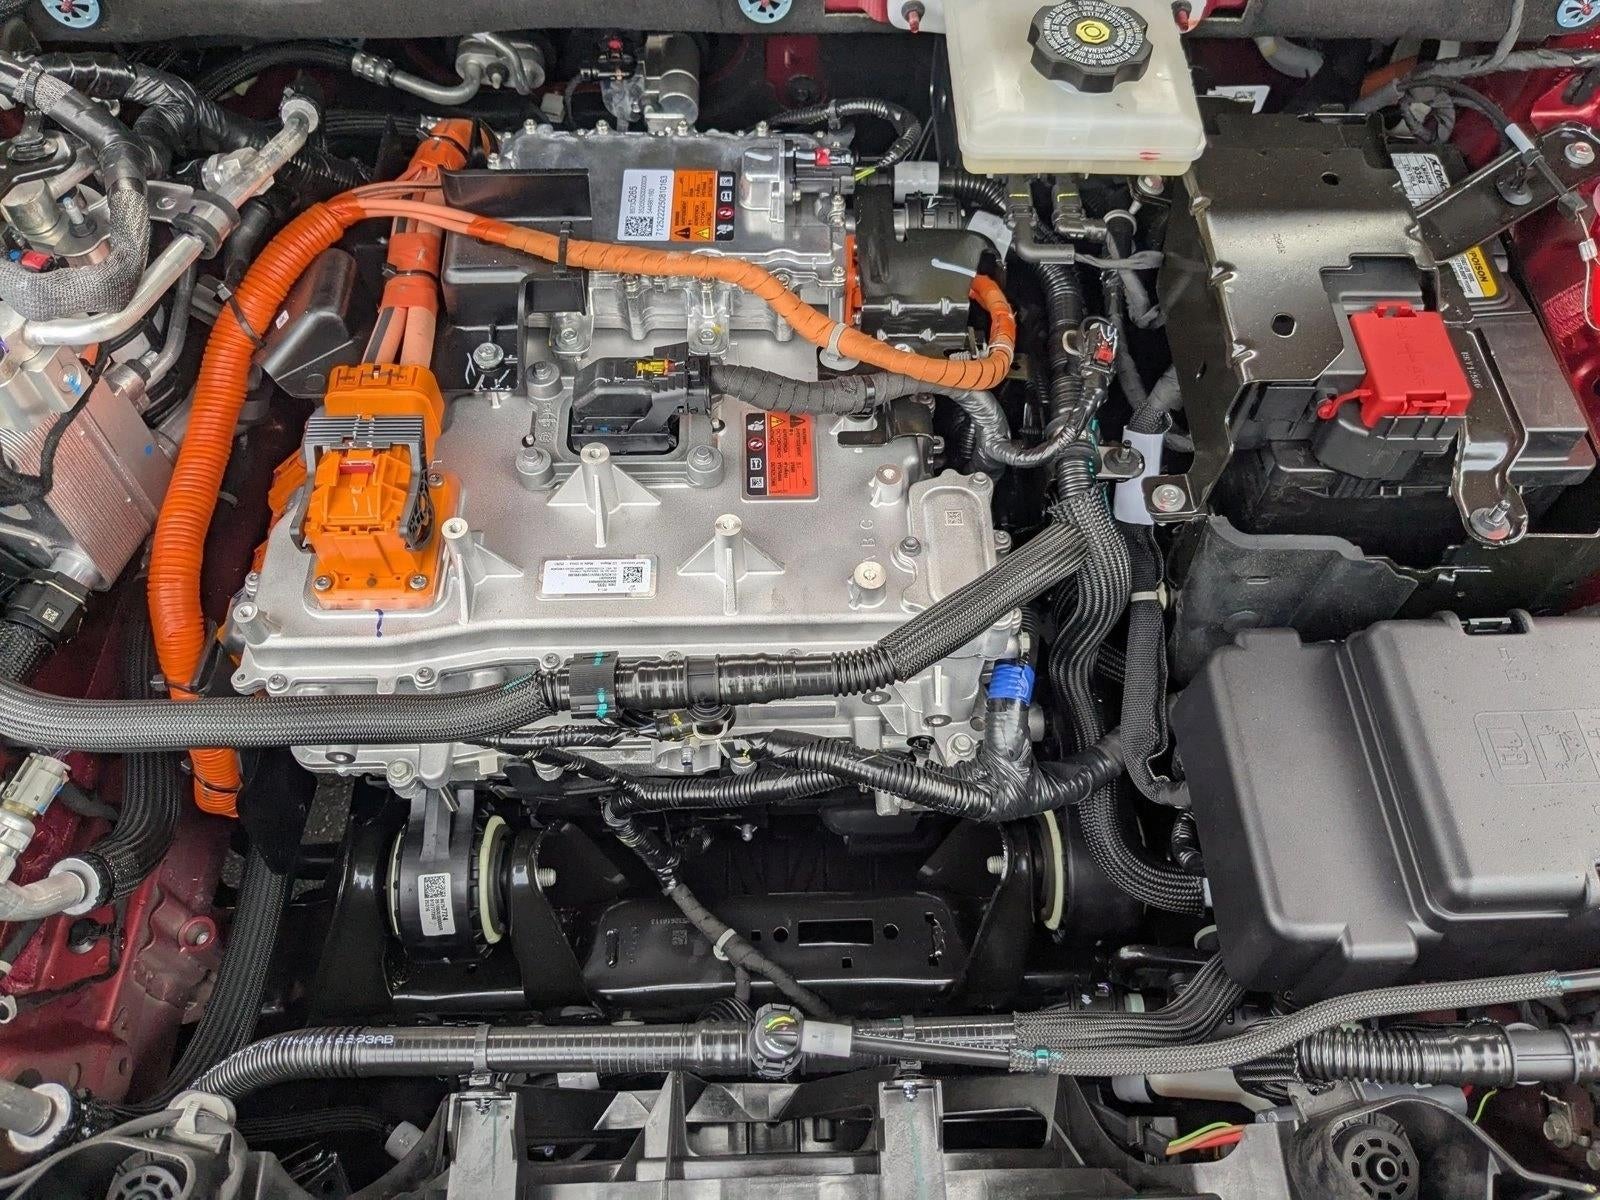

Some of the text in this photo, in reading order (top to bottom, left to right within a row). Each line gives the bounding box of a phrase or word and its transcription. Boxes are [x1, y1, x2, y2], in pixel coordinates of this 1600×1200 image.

[1110, 5, 1131, 19] SEALED
[1064, 52, 1095, 65] NETTOYER
[1072, 48, 1086, 57] QUE
[1412, 166, 1425, 185] 9352
